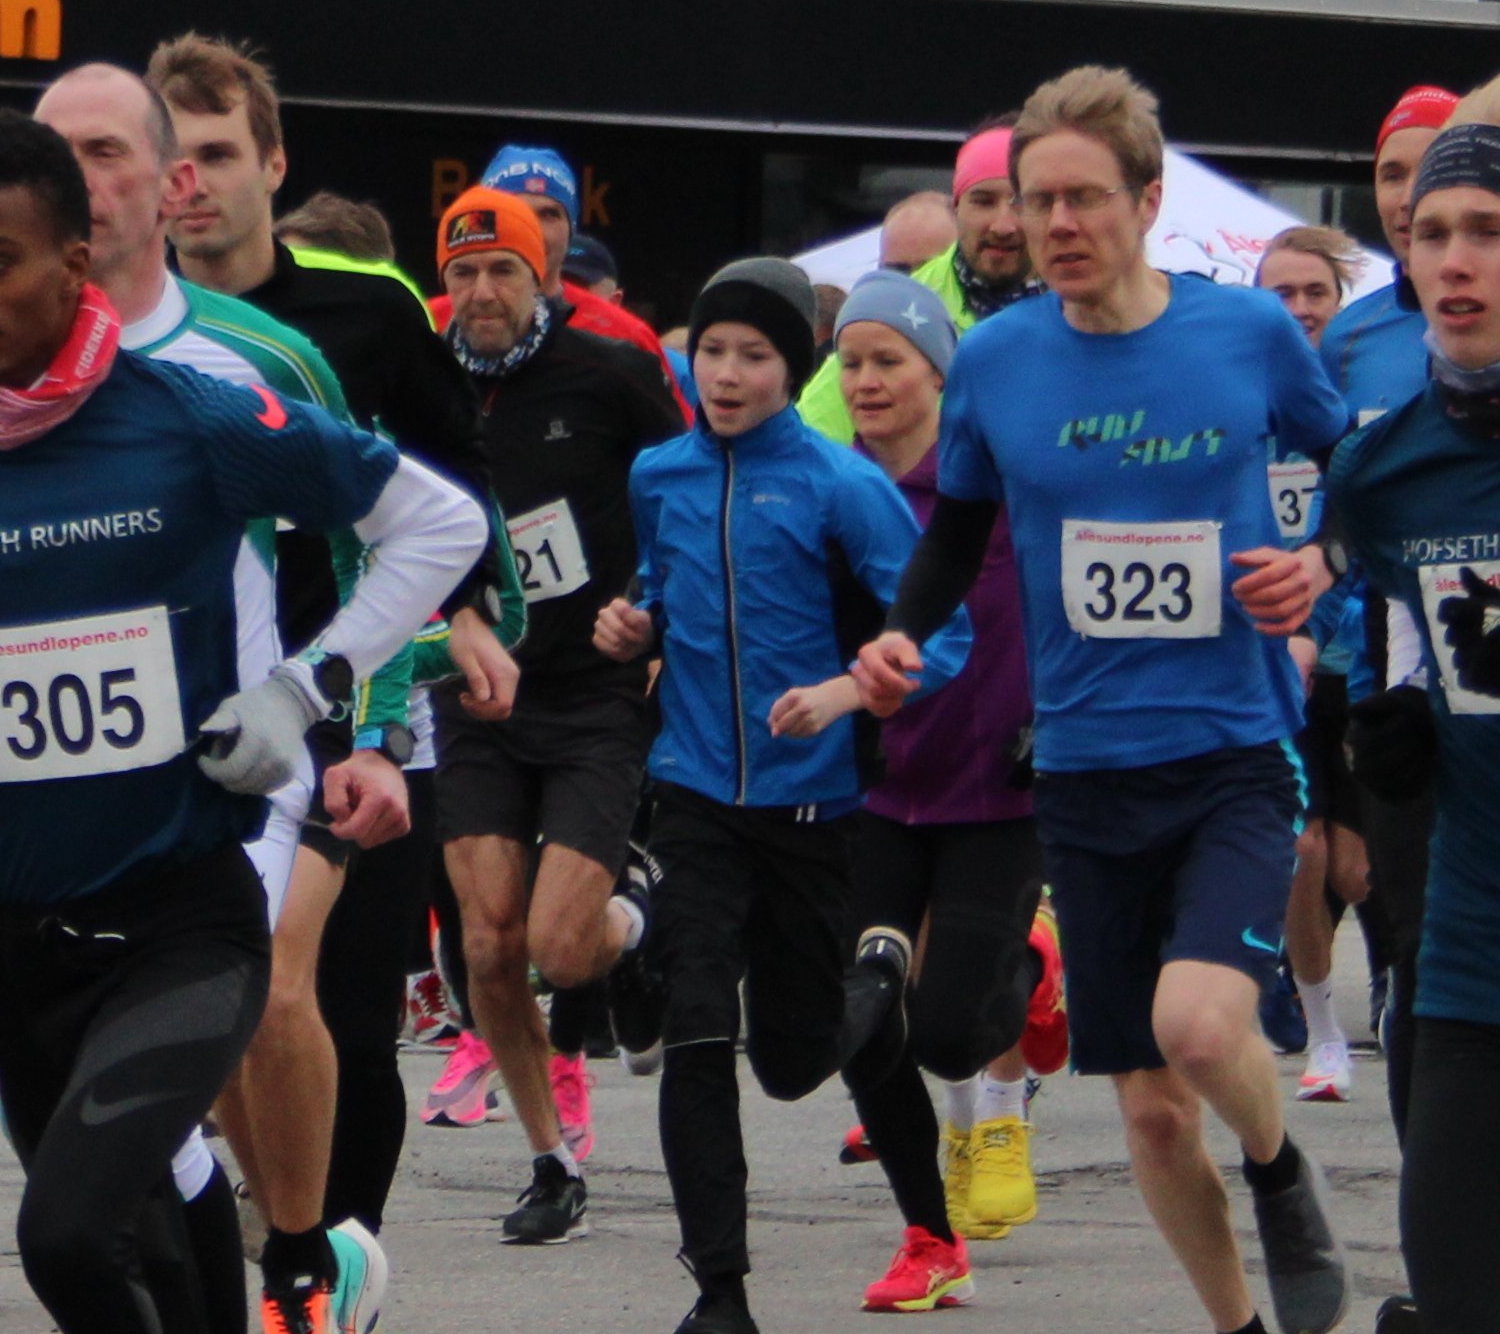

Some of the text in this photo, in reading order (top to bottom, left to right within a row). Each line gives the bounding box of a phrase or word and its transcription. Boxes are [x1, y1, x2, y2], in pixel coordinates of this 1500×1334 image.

[31, 508, 163, 550] RUNNERS
[1403, 533, 1499, 563] HOFSETH
[517, 538, 563, 591] 21
[1084, 561, 1195, 624] 323
[2, 667, 145, 761] 305
